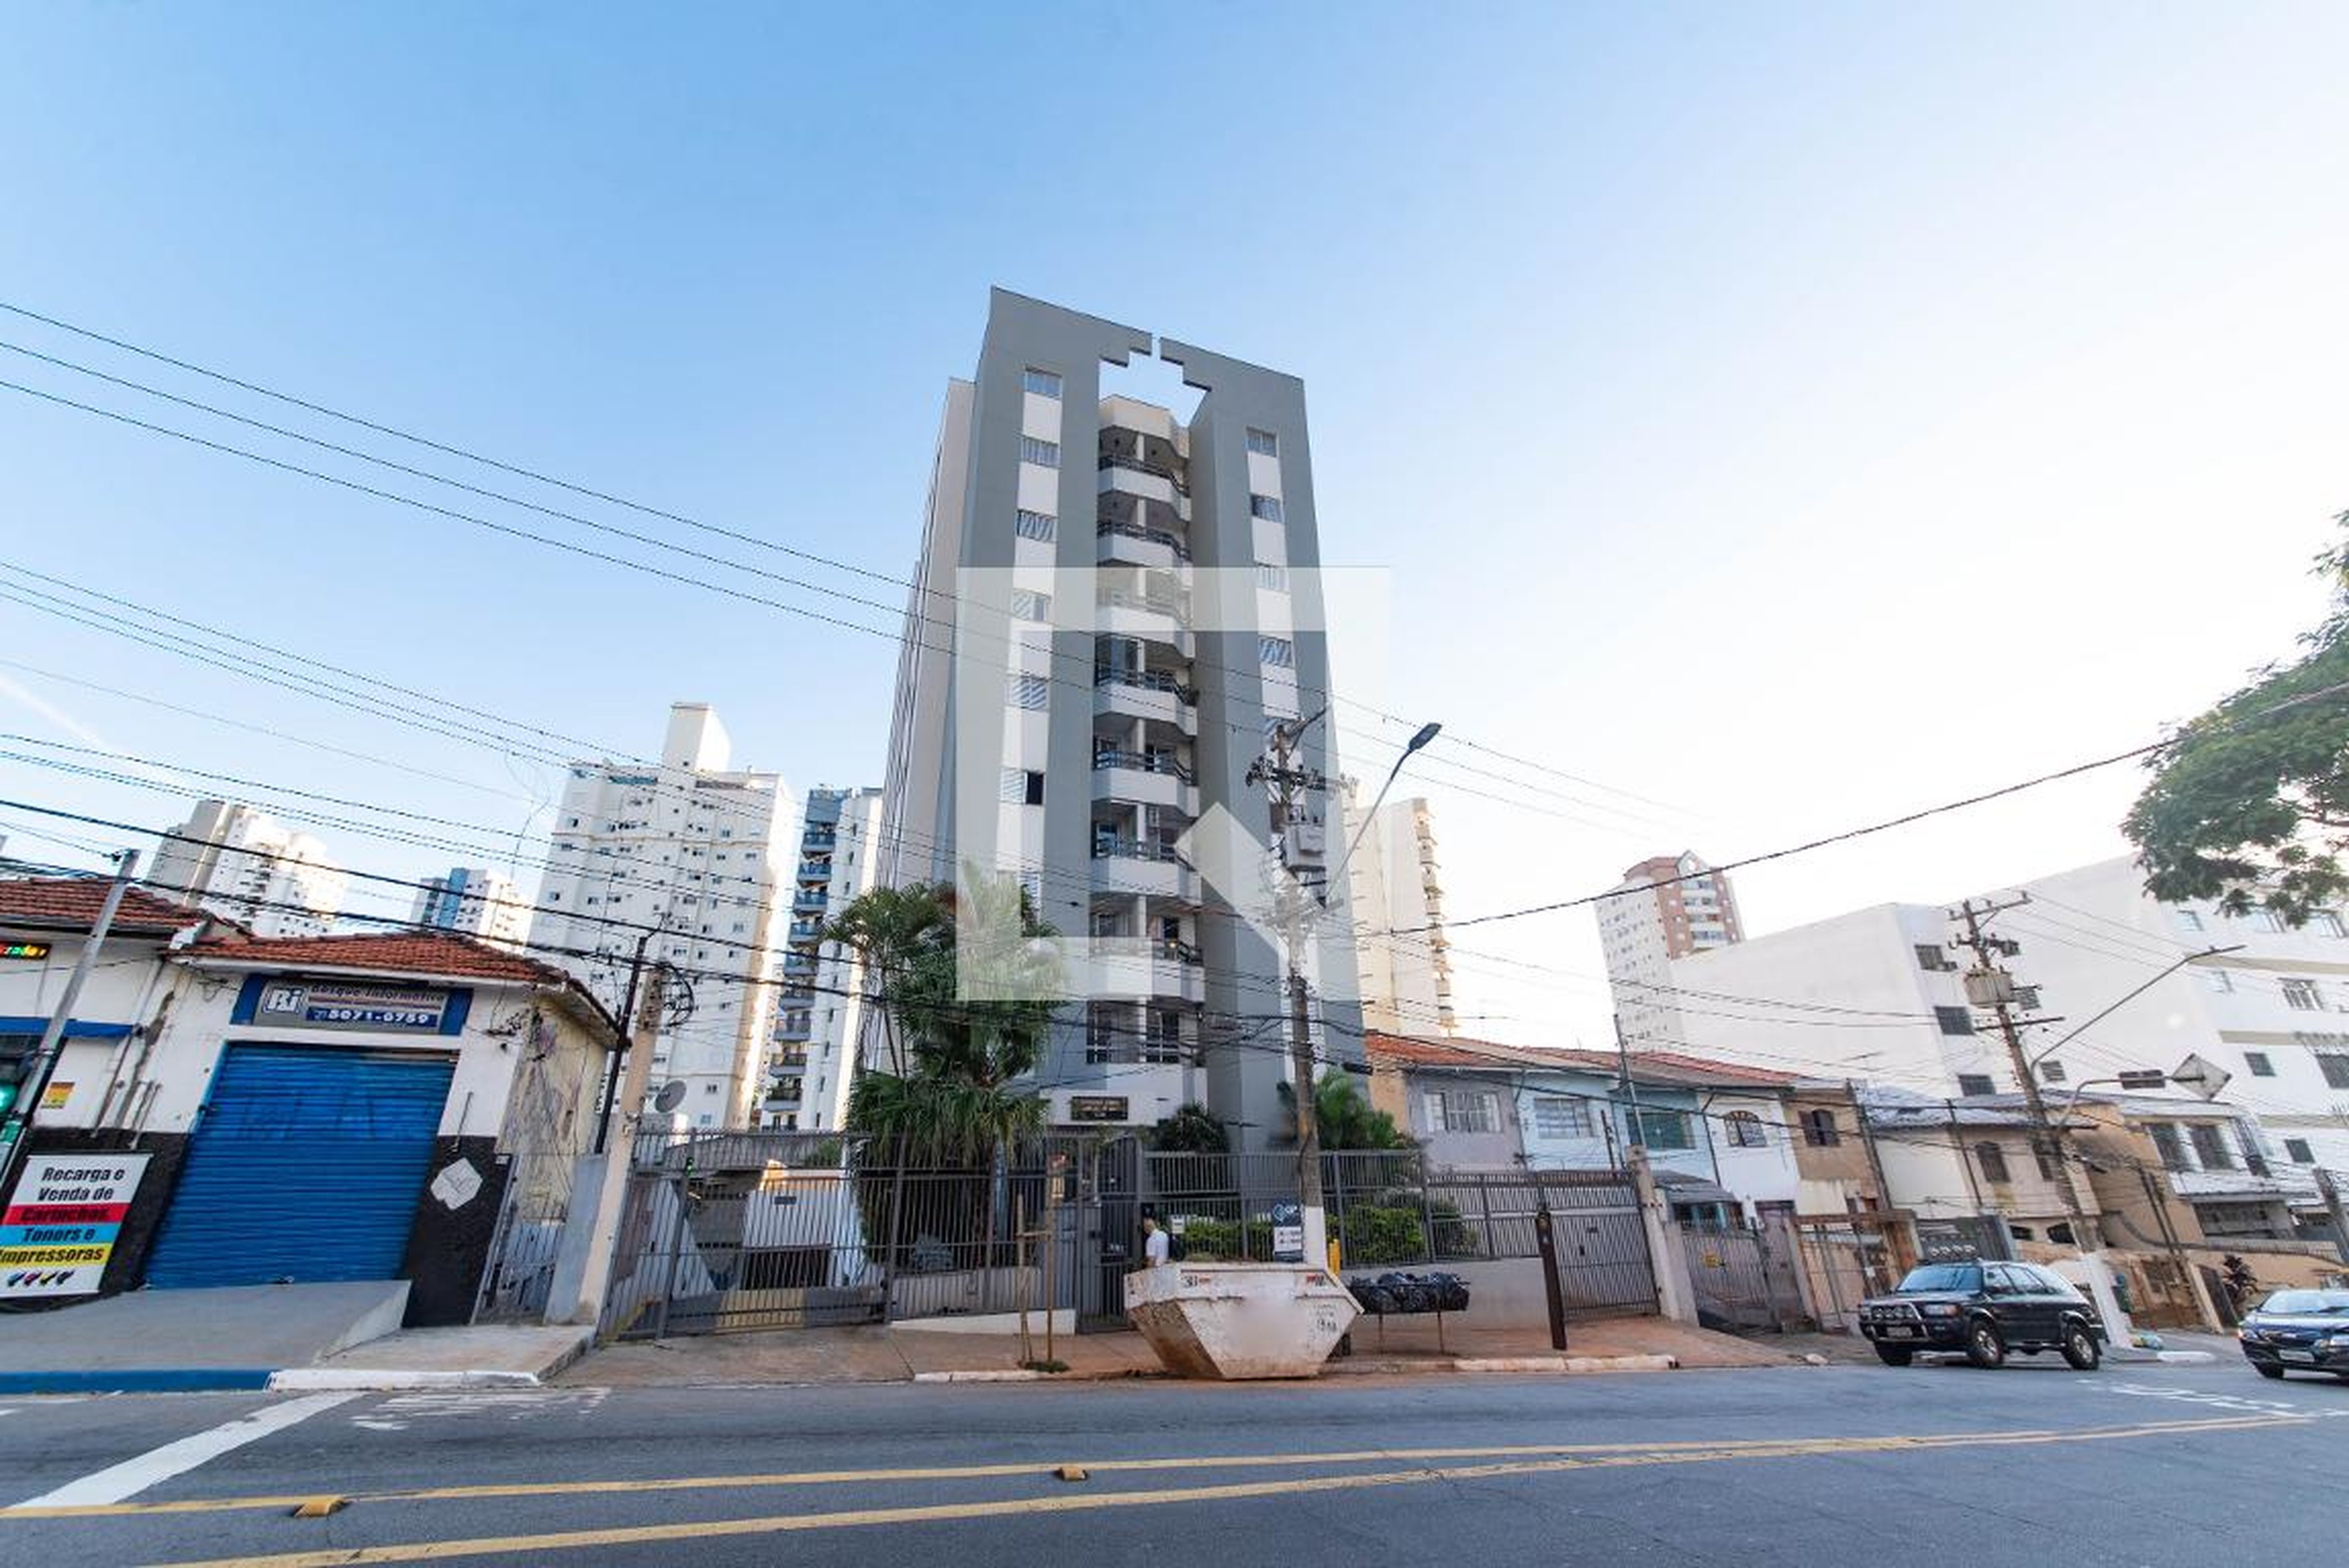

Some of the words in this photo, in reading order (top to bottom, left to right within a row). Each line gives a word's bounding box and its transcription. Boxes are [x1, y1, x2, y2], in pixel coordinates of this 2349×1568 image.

[41, 1167, 112, 1183] Recarga
[113, 1169, 125, 1181] e
[37, 1188, 91, 1201] Venda
[92, 1186, 114, 1200] de
[23, 1227, 81, 1243] Toners
[83, 1228, 96, 1240] e
